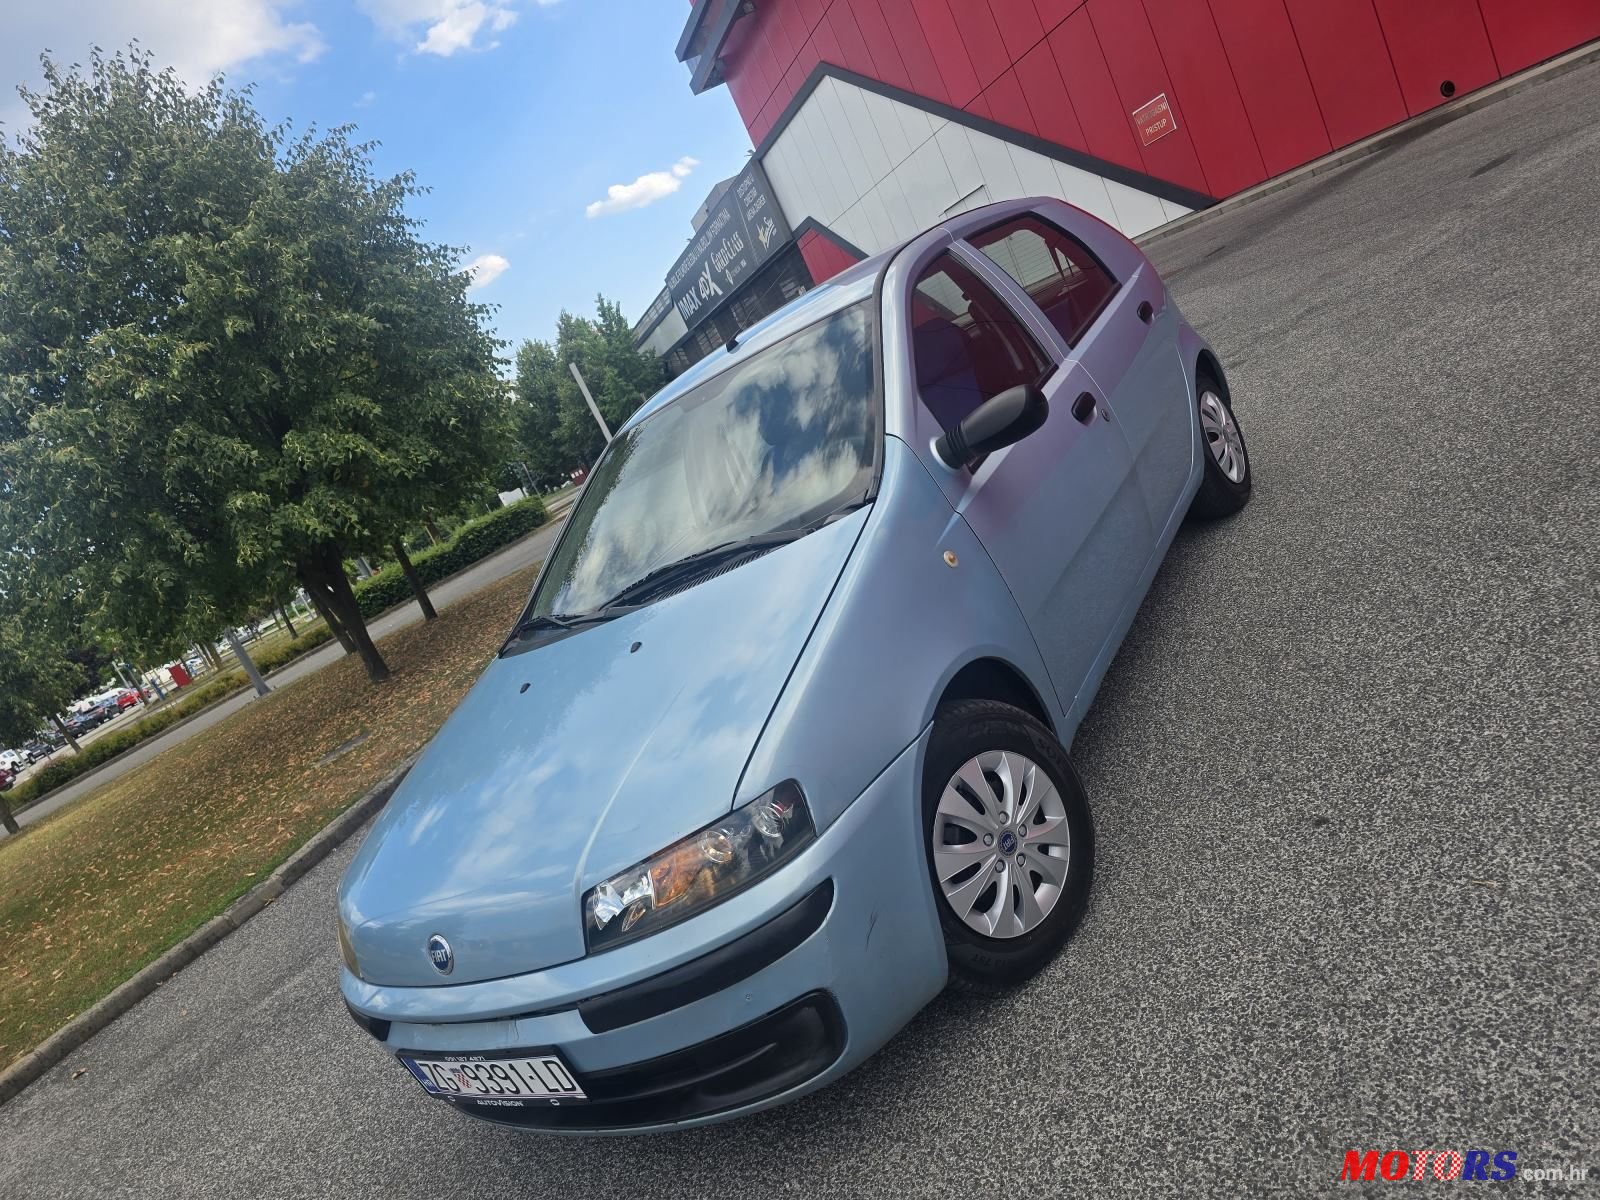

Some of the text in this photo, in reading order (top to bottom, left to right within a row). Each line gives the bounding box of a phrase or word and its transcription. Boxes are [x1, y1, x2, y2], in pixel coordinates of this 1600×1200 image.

[678, 286, 702, 320] IMAX
[431, 949, 447, 962] FIAT
[418, 1063, 461, 1092] ZG
